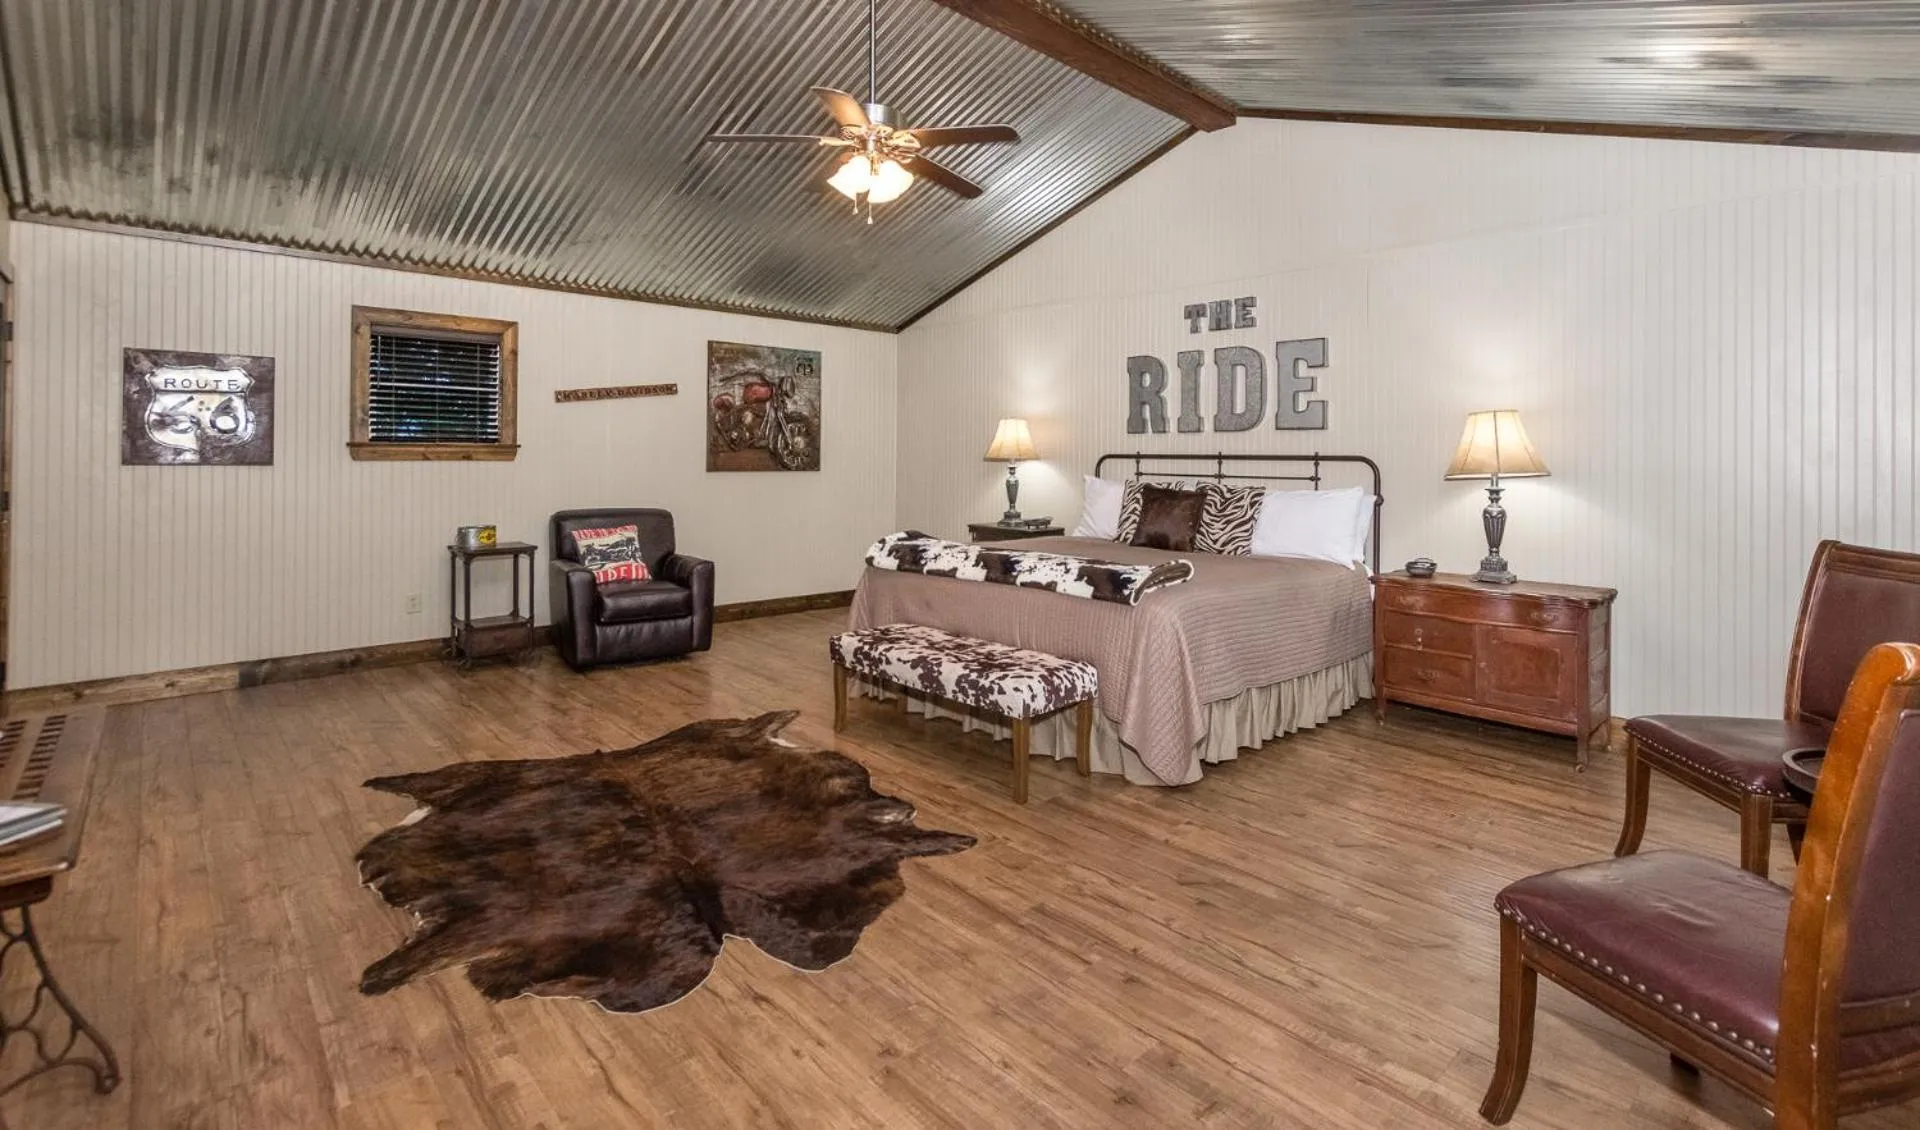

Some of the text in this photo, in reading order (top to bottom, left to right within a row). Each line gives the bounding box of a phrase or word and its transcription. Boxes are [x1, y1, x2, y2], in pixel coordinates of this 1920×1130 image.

[1184, 296, 1257, 334] THE
[163, 377, 242, 391] ROUTE
[1126, 337, 1329, 434] RIDE
